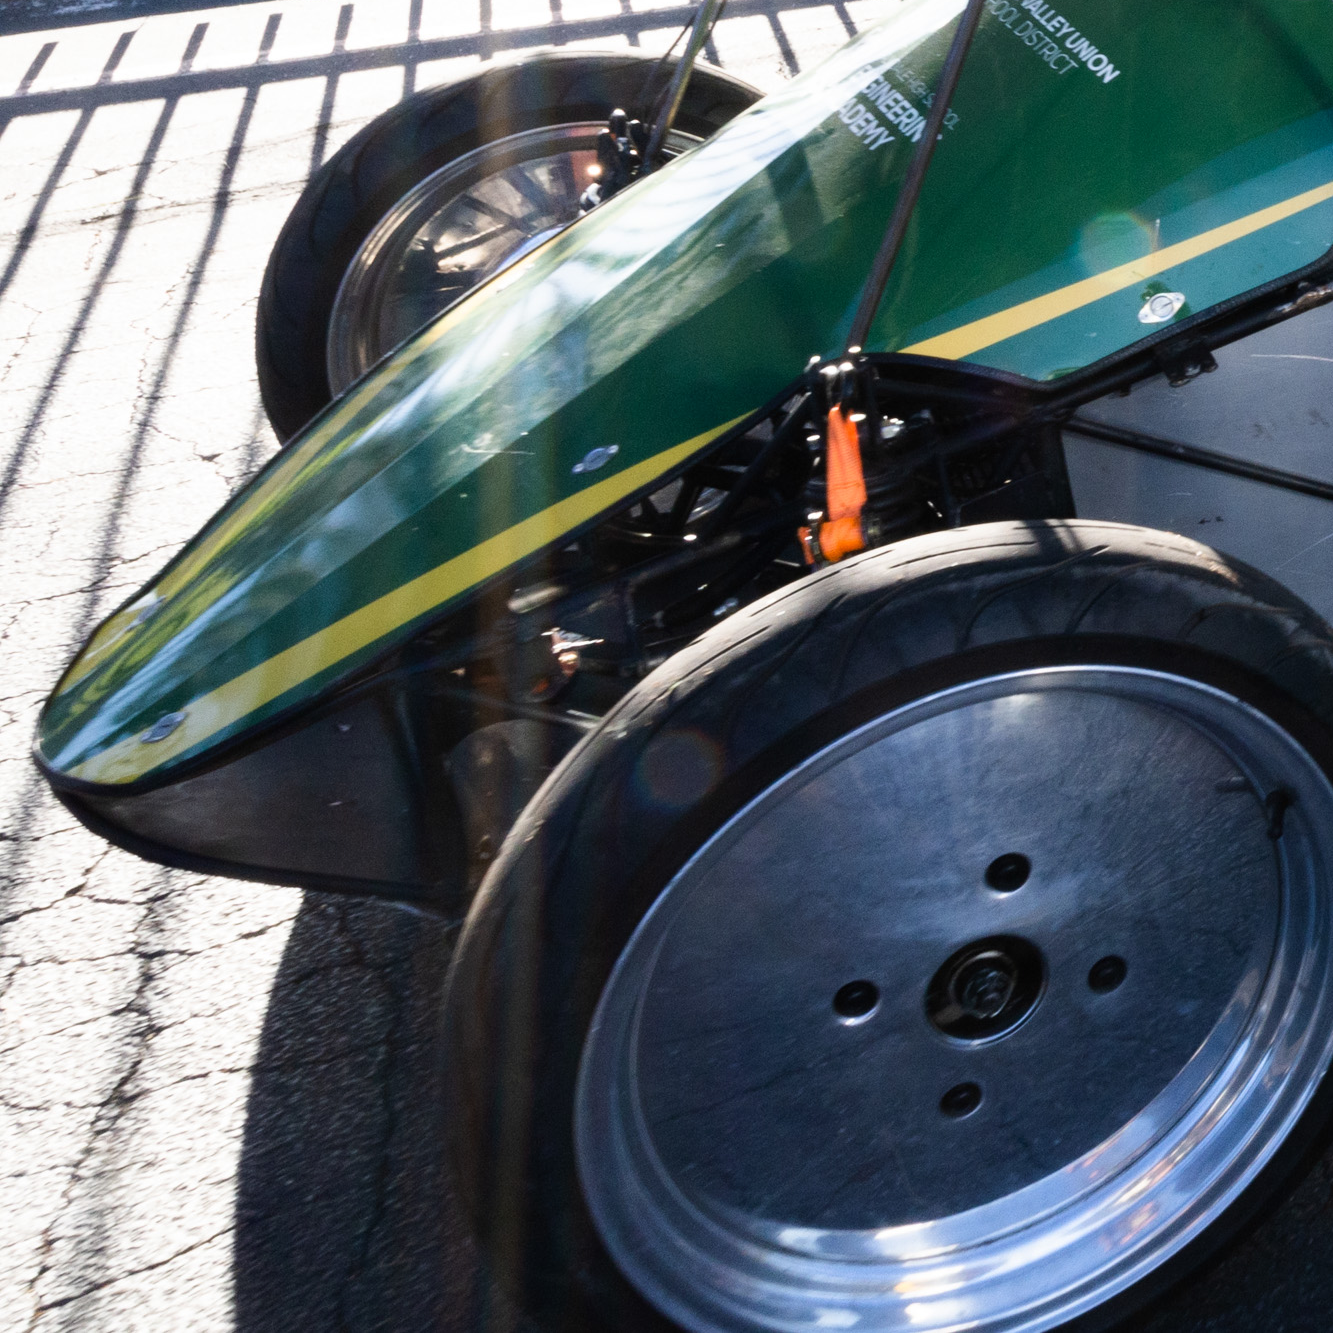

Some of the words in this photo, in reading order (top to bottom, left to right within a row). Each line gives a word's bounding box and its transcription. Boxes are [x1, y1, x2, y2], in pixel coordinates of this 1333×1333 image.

[1013, 20, 1079, 74] DISTRICT
[1065, 32, 1121, 84] UNION
[838, 98, 896, 151] ADEMY
